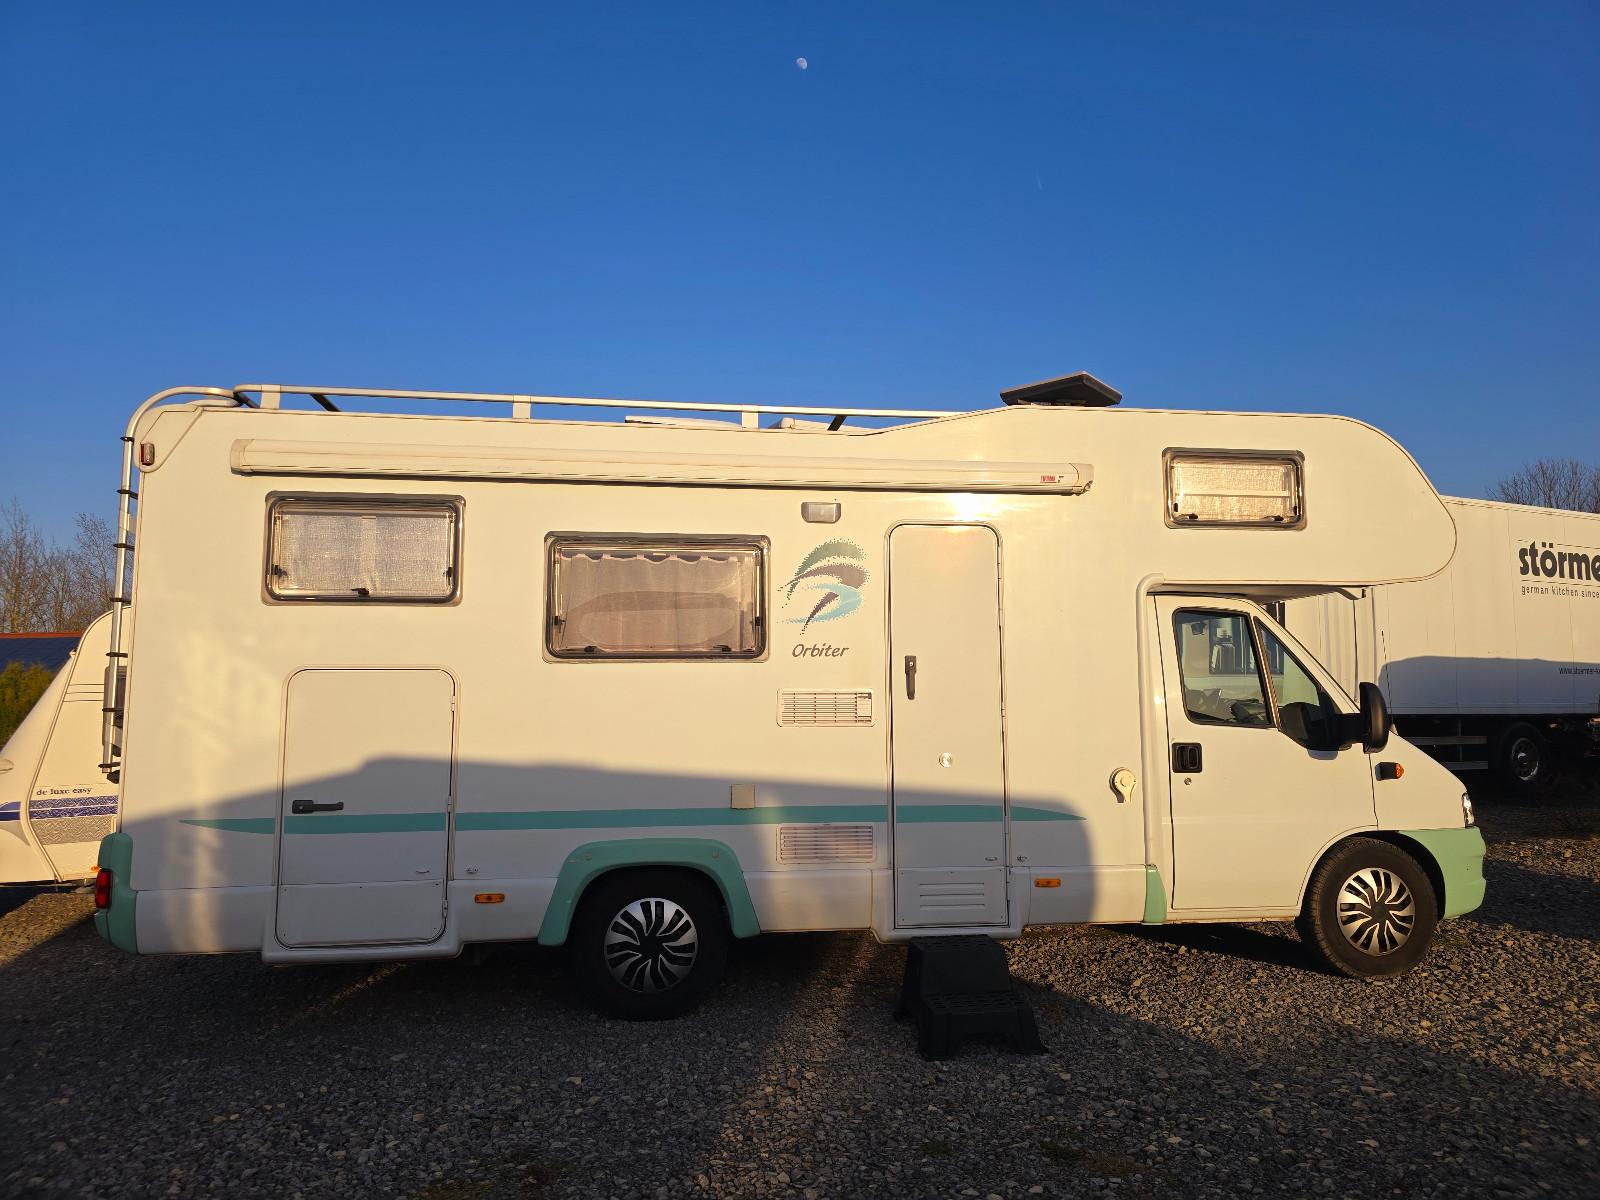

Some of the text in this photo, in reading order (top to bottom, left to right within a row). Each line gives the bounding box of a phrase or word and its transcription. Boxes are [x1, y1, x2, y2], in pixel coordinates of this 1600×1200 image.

[1519, 541, 1600, 582] störme
[1521, 586, 1600, 598] german kitchen since
[792, 643, 850, 657] Orbiter
